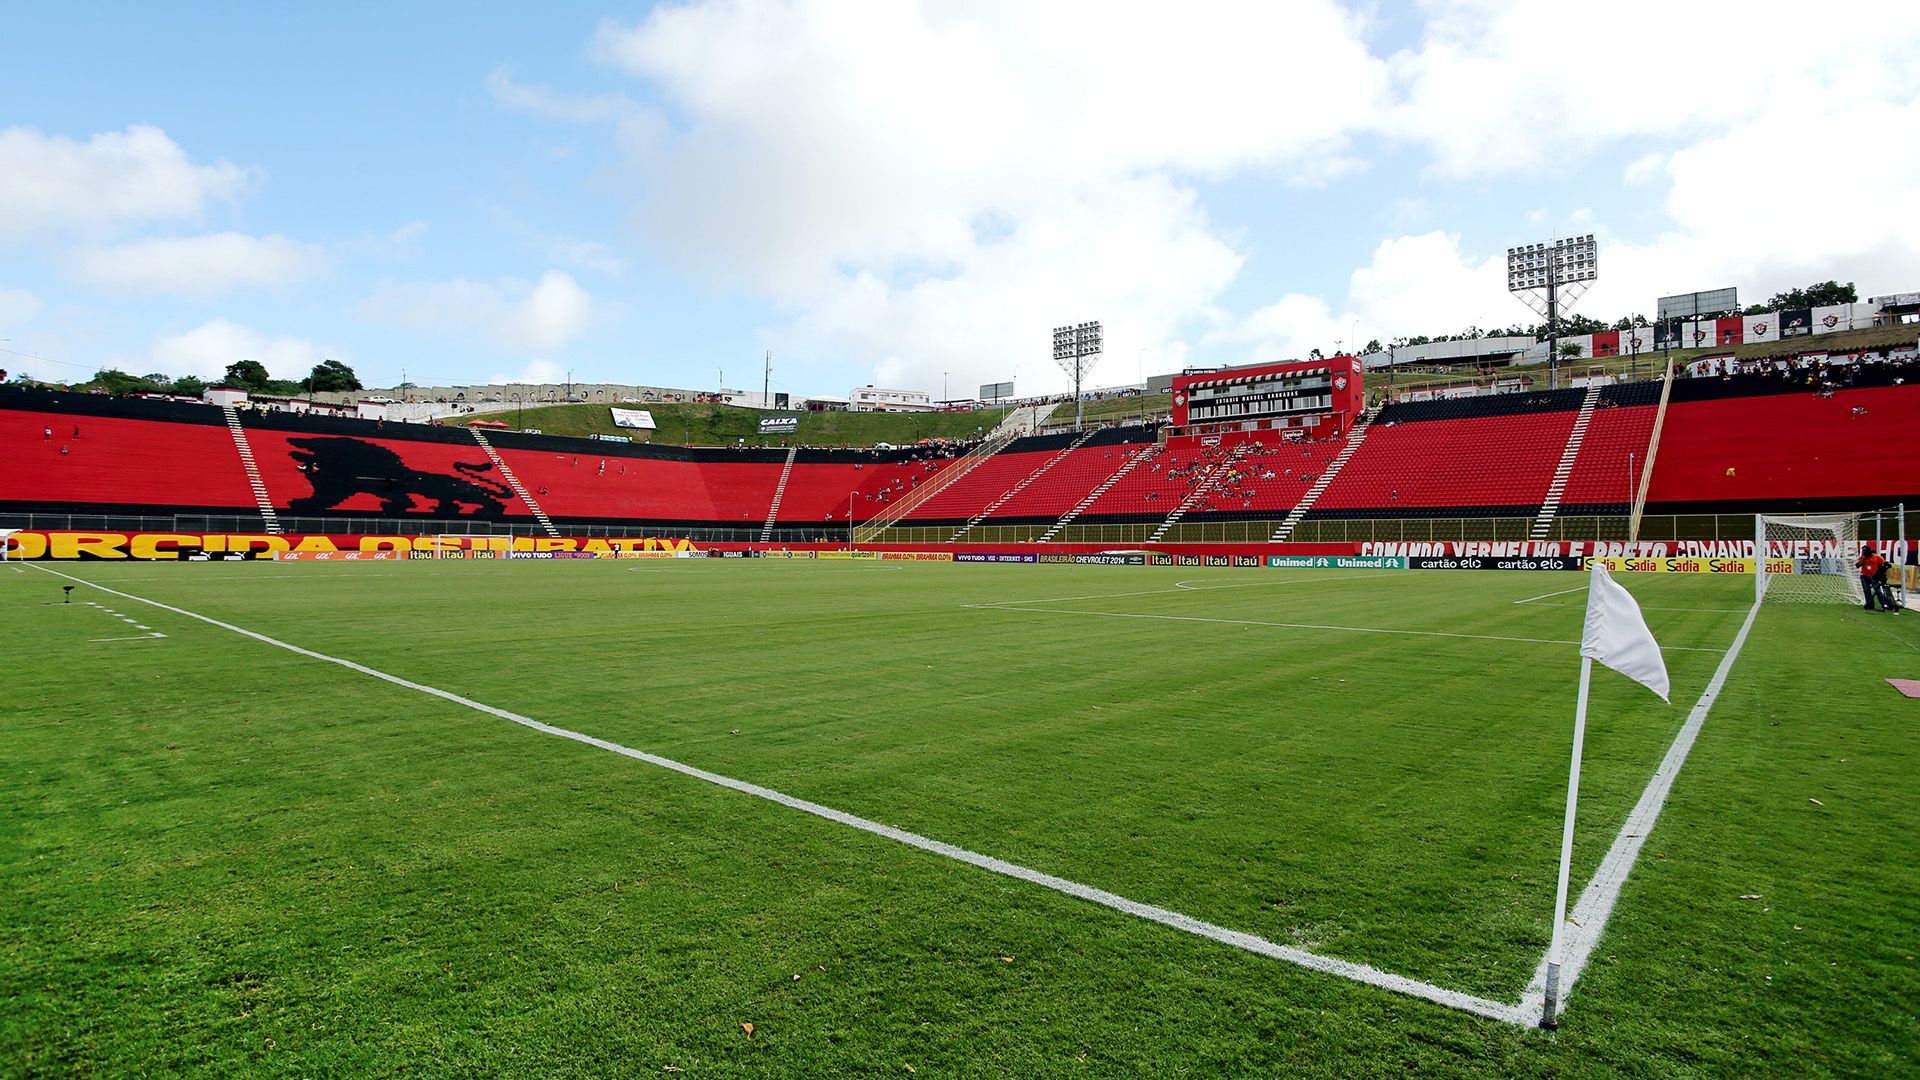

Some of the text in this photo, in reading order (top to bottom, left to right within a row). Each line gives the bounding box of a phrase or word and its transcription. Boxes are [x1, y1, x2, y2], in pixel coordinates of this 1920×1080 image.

[760, 417, 798, 426] CAIXA
[410, 550, 432, 559] Itaú
[443, 550, 464, 559] Itaú
[474, 550, 494, 559] Itaú
[1361, 541, 1668, 558] COMANDO VERMELHO E PRETO
[1040, 554, 1125, 564] BRASILEIRÃO CHEVROLET 2014
[1152, 555, 1172, 565] Itaú
[1178, 555, 1199, 565] Itaú
[1206, 555, 1228, 566] Itaú
[1234, 555, 1257, 566] Itaú
[1272, 558, 1314, 567] Unimed
[1337, 558, 1382, 568] Unimed
[1421, 558, 1482, 569] cartão elo
[1498, 560, 1564, 570] cartão elo
[1624, 558, 1656, 571] Sadia
[1666, 559, 1700, 572] Sadia
[1709, 559, 1744, 573] Sadia
